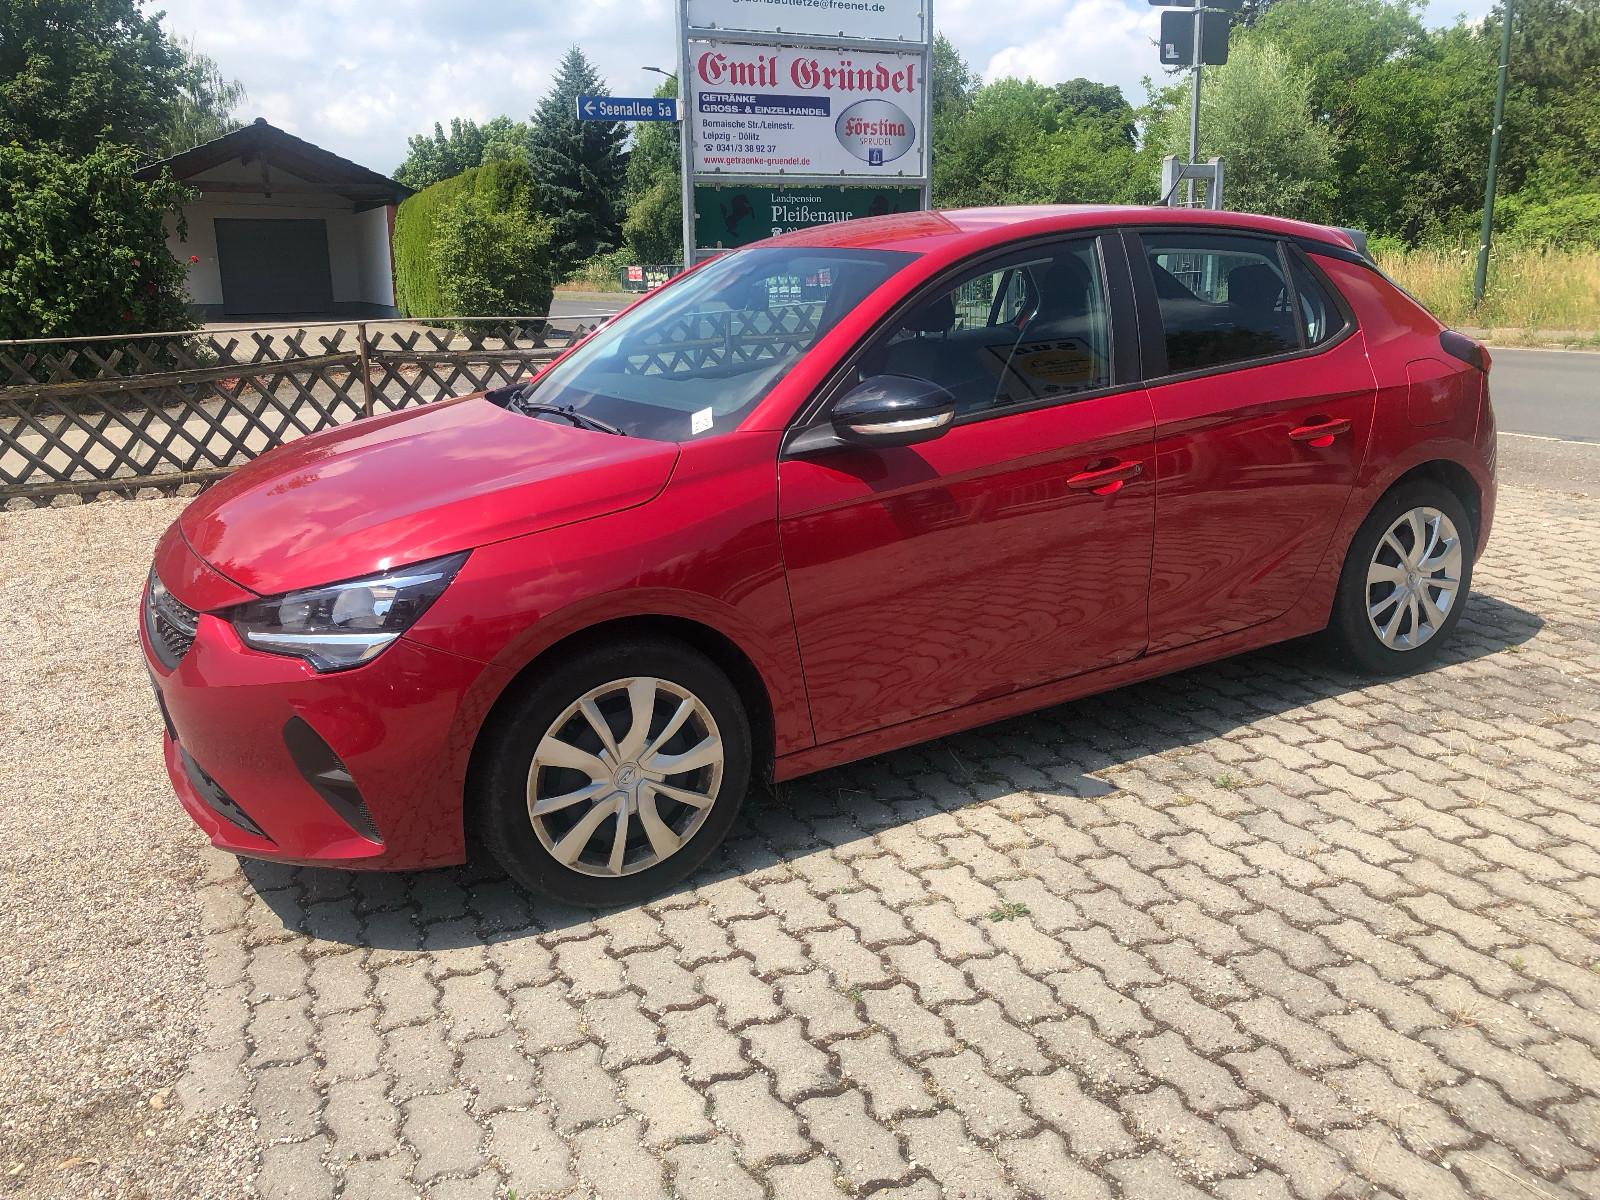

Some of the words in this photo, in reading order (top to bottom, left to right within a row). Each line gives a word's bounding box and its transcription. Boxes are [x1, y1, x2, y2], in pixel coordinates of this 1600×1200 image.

[697, 51, 778, 88] Emil
[790, 57, 915, 94] Gründel
[702, 94, 756, 103] GETRÄNKE
[600, 101, 653, 117] Seenallee
[658, 103, 672, 117] 5a
[702, 104, 742, 113] GROSS-
[745, 105, 753, 114] &
[755, 106, 827, 116] EINZELHANDEL
[702, 119, 746, 128] Bornaische
[845, 117, 906, 136] Förstina
[702, 131, 731, 141] Leipzig
[738, 132, 760, 141] Dölitz
[860, 137, 892, 146] SPRUDEL
[744, 144, 754, 153] 38
[755, 145, 765, 153] 92
[767, 145, 777, 153] 37
[703, 156, 811, 166] www.getraenke-gruendel.de
[771, 193, 822, 204] Landpension
[771, 205, 853, 223] Pleißenaue
